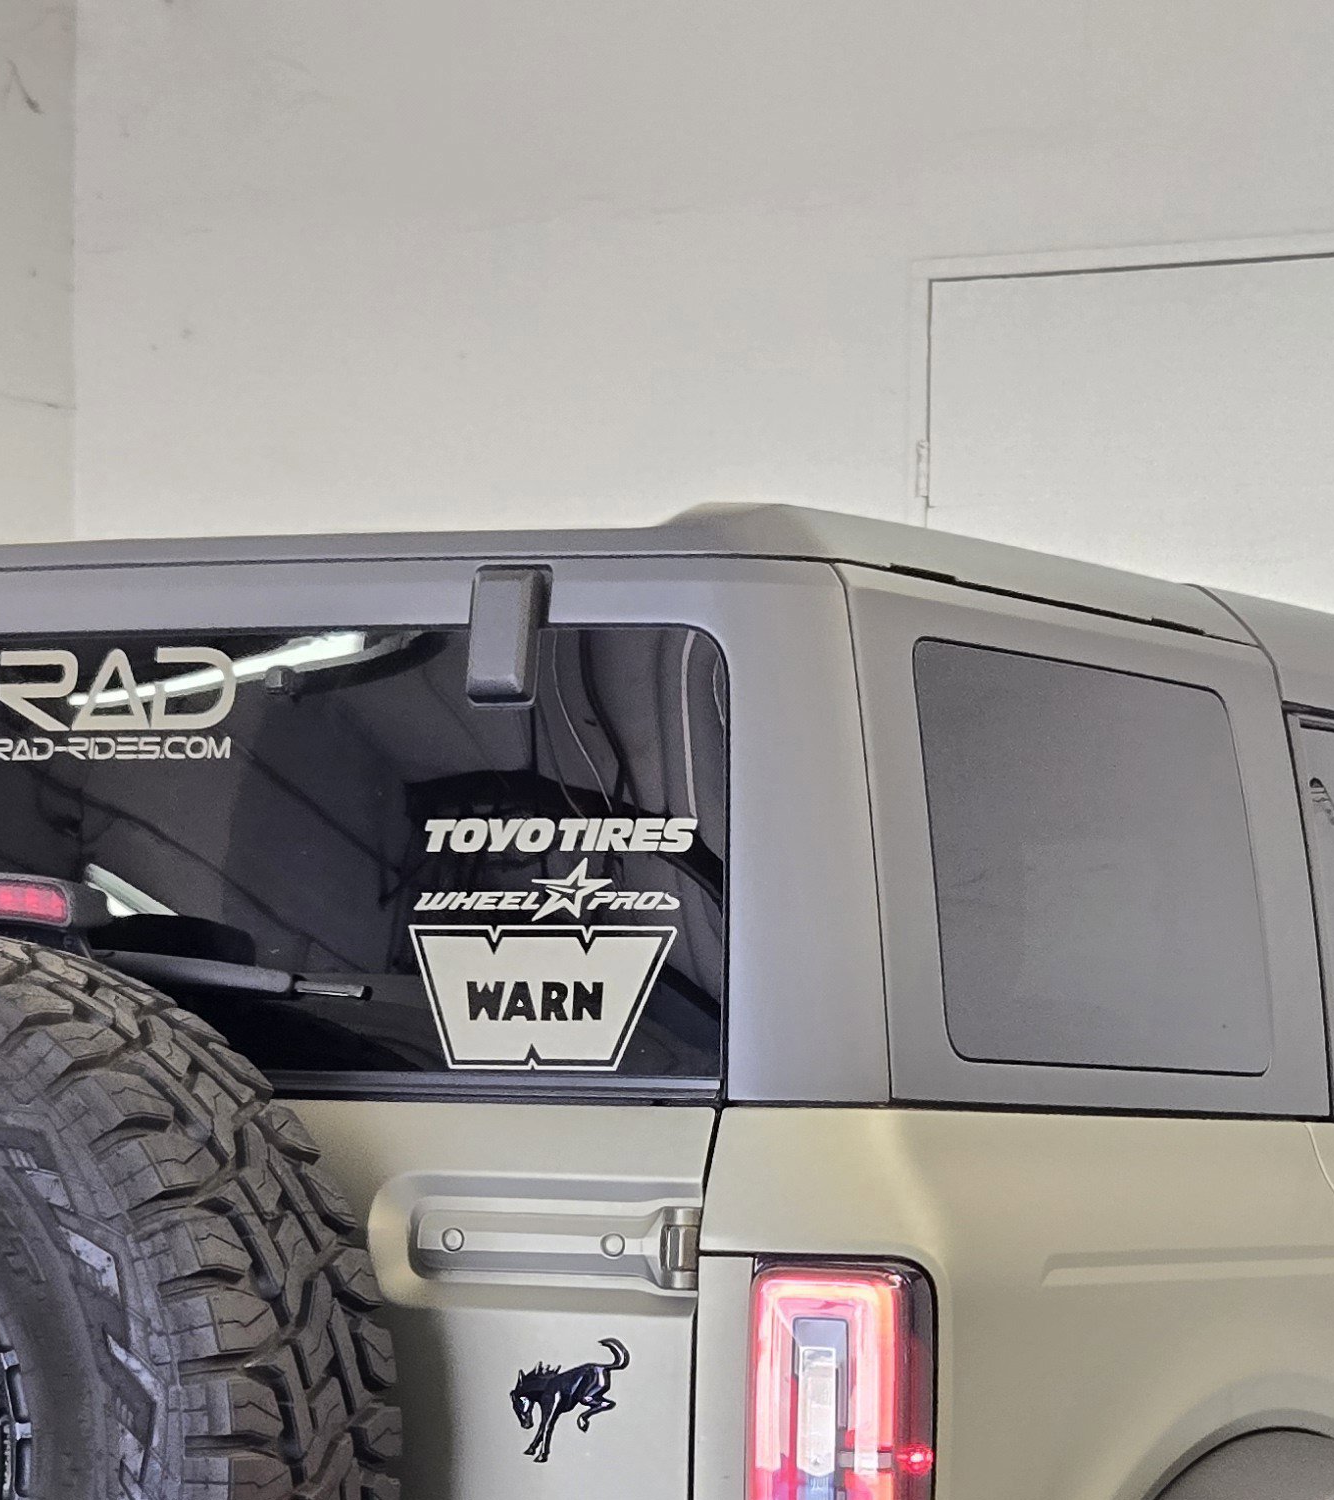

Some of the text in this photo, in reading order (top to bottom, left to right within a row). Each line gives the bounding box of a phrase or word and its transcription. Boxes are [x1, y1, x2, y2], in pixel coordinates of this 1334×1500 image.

[425, 817, 698, 853] TOYO TIRES
[414, 891, 681, 911] WHEEL PROS
[466, 980, 604, 1021] WARN
